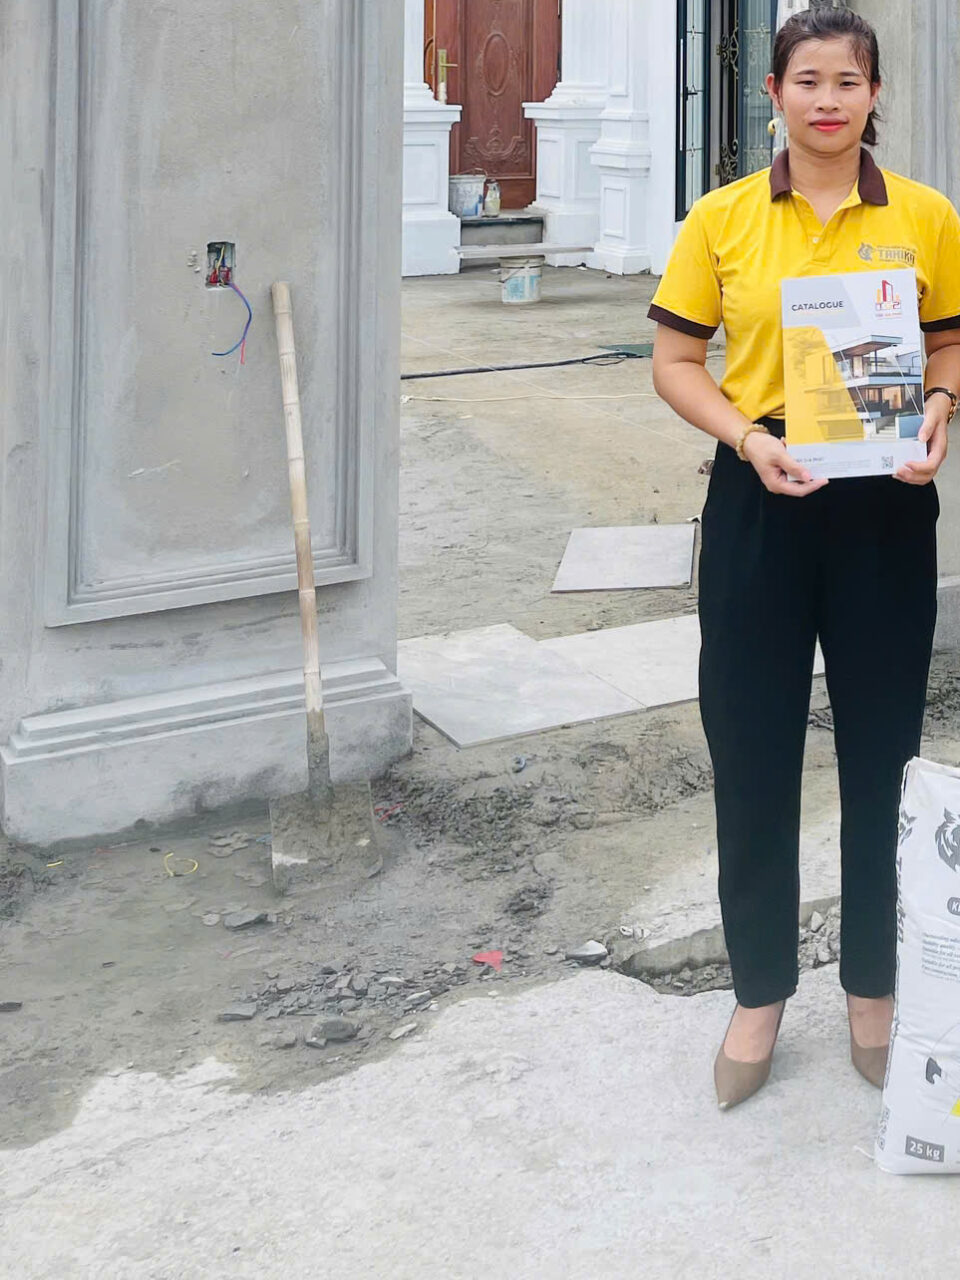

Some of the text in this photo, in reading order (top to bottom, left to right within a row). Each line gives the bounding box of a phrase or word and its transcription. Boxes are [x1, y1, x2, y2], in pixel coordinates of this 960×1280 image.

[791, 300, 844, 311] CATALOGUE
[910, 1141, 940, 1160] 25 kg
